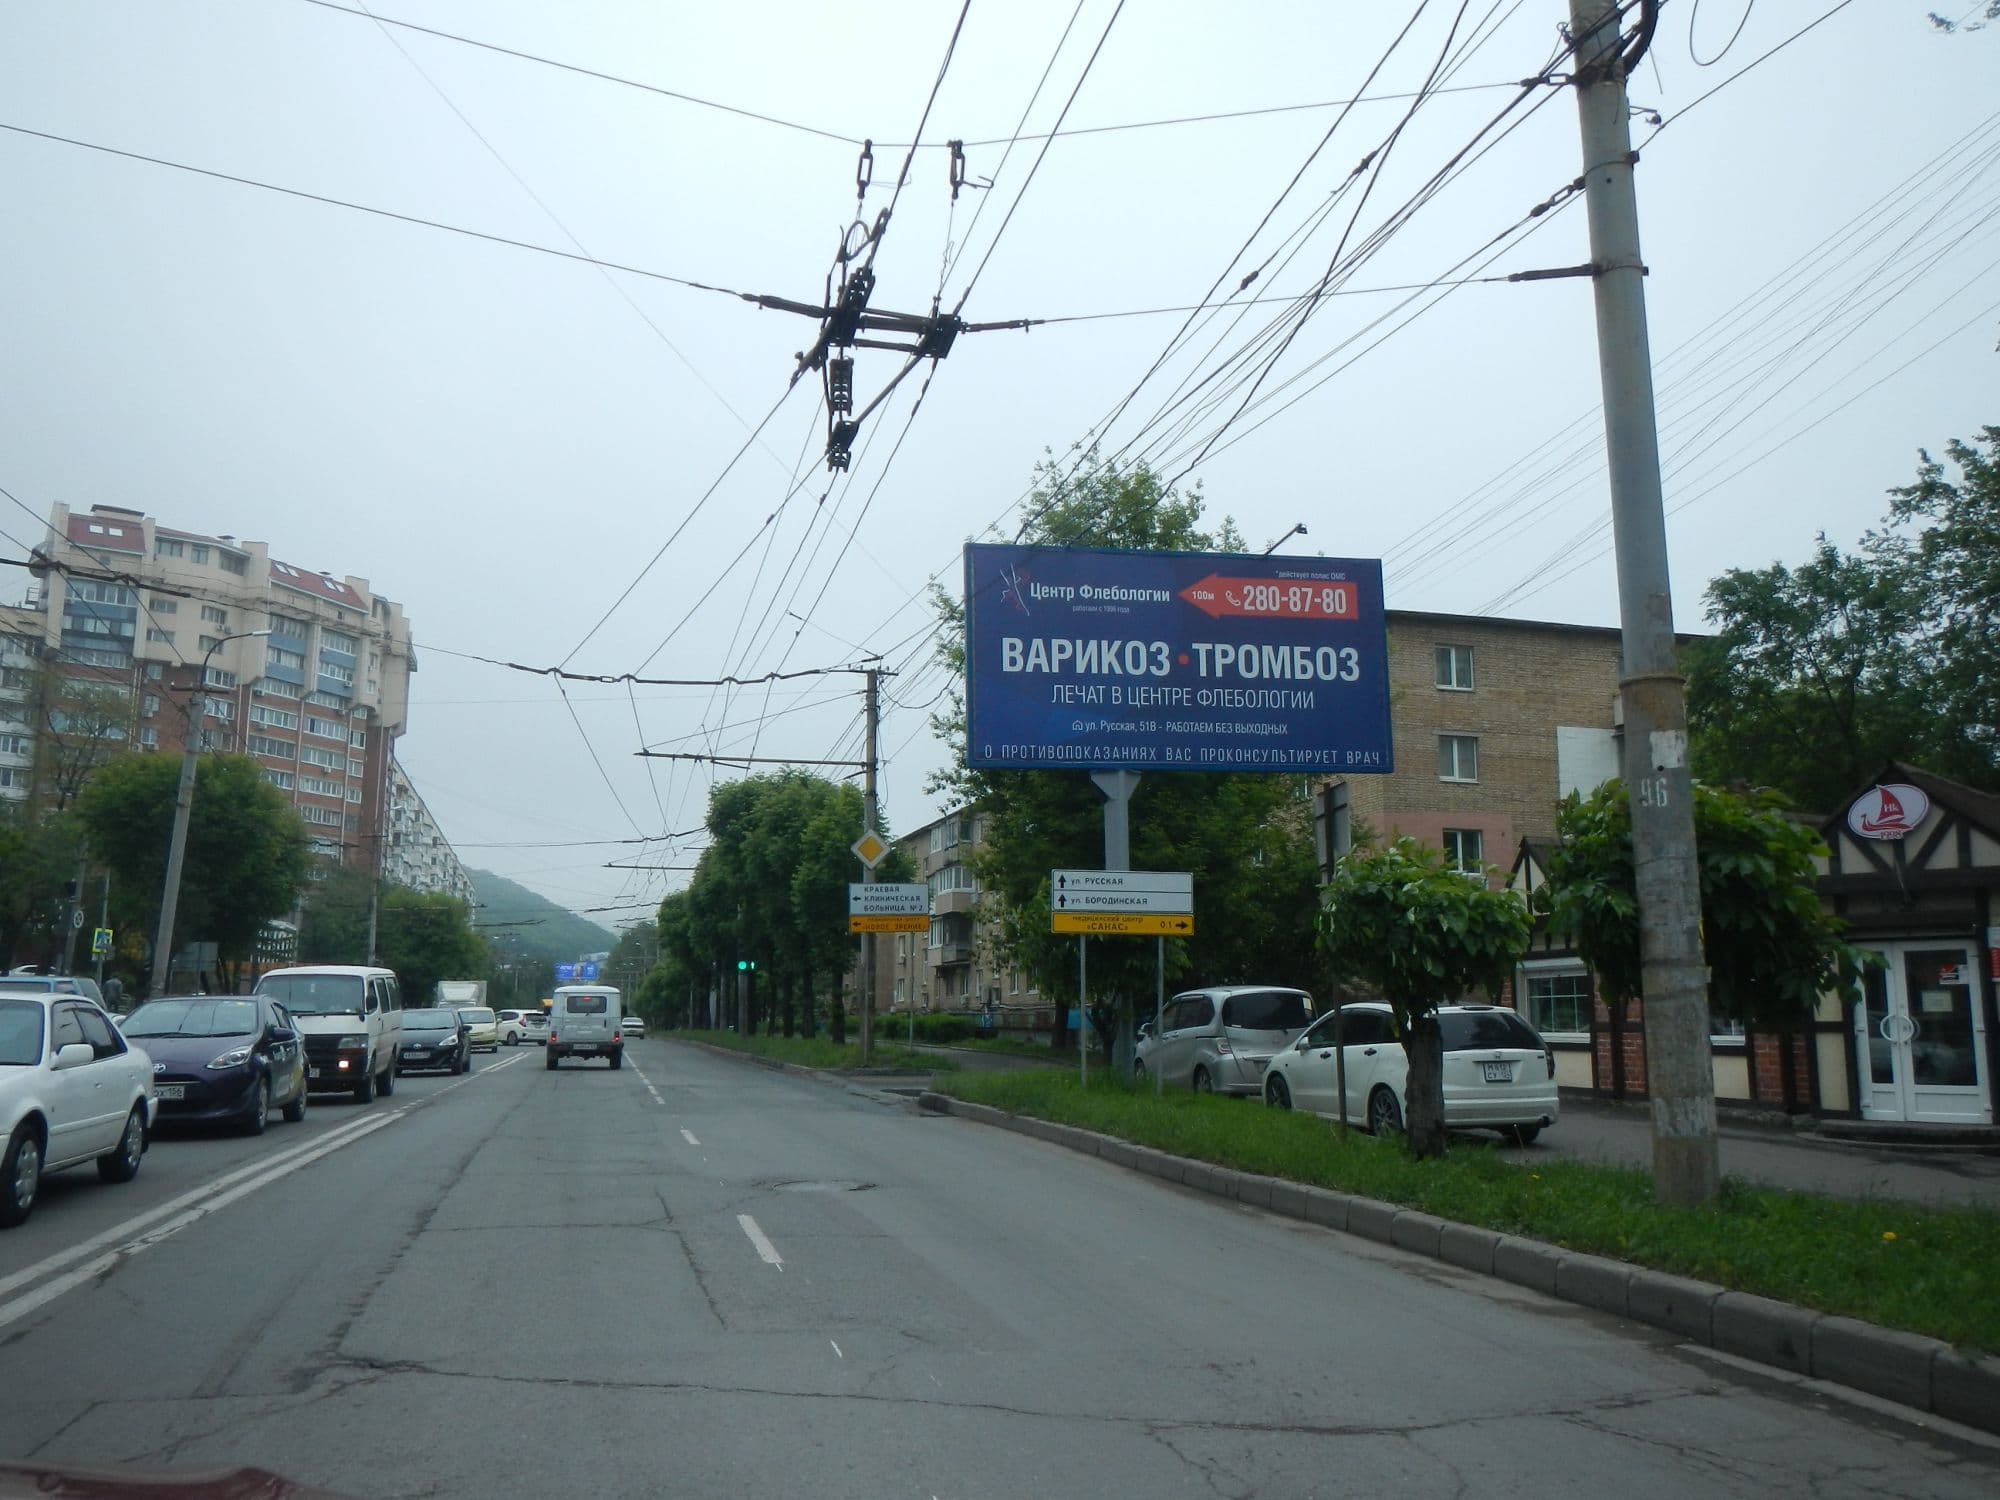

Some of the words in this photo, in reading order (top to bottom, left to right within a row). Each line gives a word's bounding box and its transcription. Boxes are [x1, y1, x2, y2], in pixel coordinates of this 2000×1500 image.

[1030, 582, 1075, 601] Центр
[1079, 584, 1170, 602] Флебологии
[1191, 590, 1215, 600] 100м
[1243, 585, 1347, 614] 280-87-80
[1002, 637, 1171, 677] ВАРИКОЗ
[1192, 643, 1360, 682] ТРОМБОЗ
[1052, 684, 1106, 704] ЛЕЧАТ
[1111, 686, 1122, 705] В
[1128, 686, 1192, 708] ЦЕНТРЕ
[1197, 687, 1314, 709] ФЛЕБОЛОГИИ
[1084, 722, 1098, 732] ул.
[1100, 720, 1138, 733] Русская,
[1166, 721, 1213, 733] РАБОТАЕМ
[1215, 722, 1233, 734] БЕЗ
[1235, 723, 1288, 735] ВЫХОДНЫХ
[984, 744, 992, 760] О
[1001, 744, 1157, 761] ПРОТИВОПОКАЗАНИЯХ
[1166, 747, 1192, 762] ВАС
[1200, 747, 1338, 764] ПРОКОНСУЛЬТИРУЕТ
[1346, 750, 1380, 765] ВРАЧ
[1085, 877, 1124, 886] РУССКАЯ
[1085, 897, 1148, 905] БОРОДИНСКАЯ
